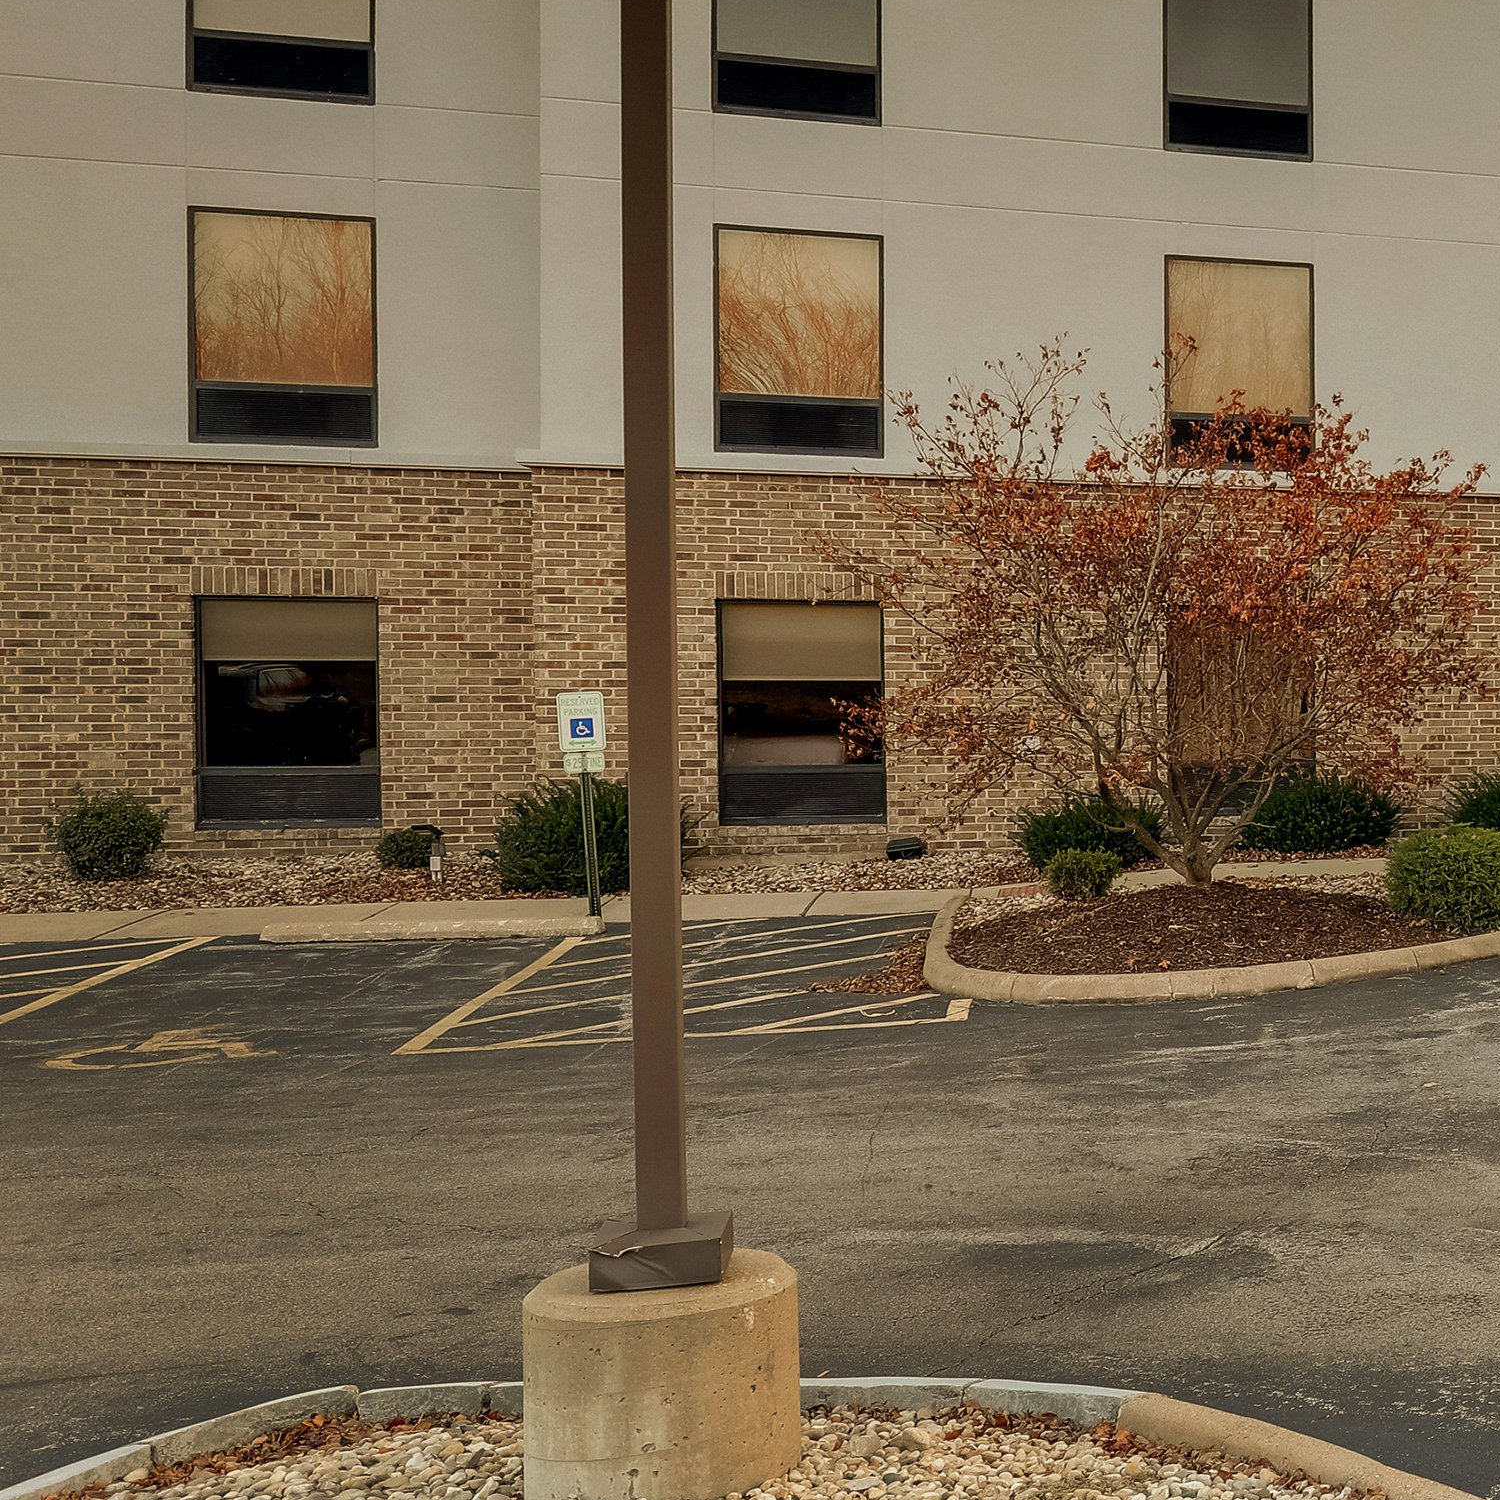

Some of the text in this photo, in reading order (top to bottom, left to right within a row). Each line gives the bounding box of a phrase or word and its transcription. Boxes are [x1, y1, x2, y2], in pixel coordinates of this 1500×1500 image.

[561, 698, 599, 706] RESERVED
[564, 707, 597, 716] PARKING
[586, 756, 603, 768] FINE
